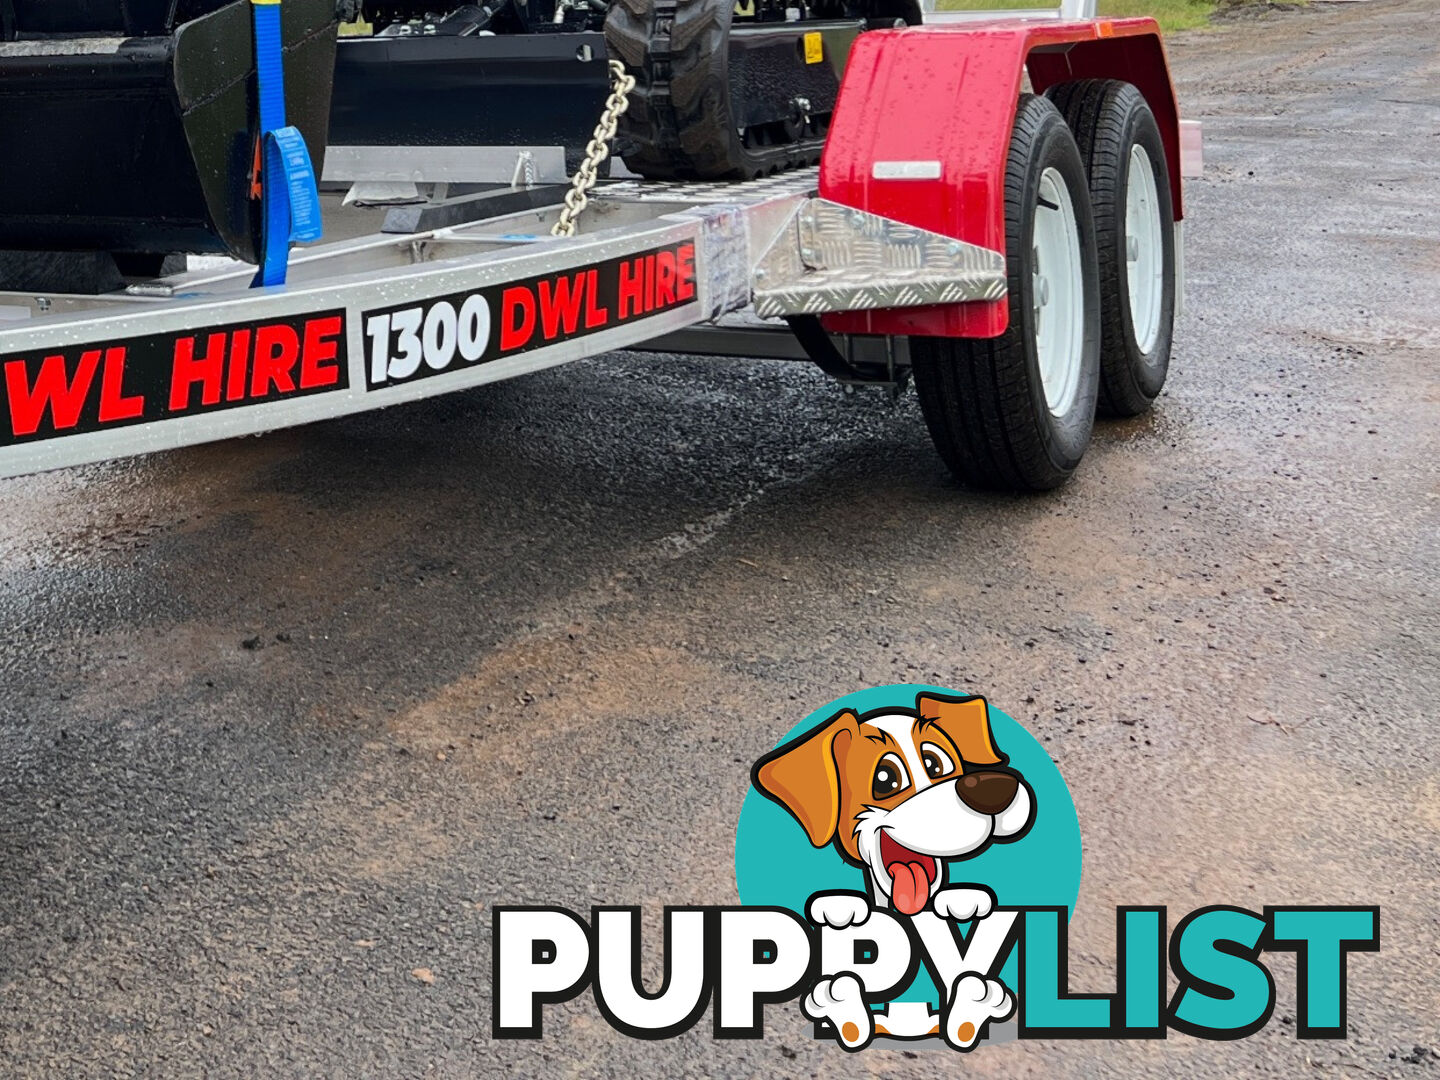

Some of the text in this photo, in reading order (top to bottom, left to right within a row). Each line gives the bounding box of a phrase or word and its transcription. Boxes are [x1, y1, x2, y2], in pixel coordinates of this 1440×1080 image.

[168, 315, 343, 411] HIRE
[366, 294, 488, 383] 1300
[500, 272, 607, 351] DWL
[617, 243, 696, 321] HIRE
